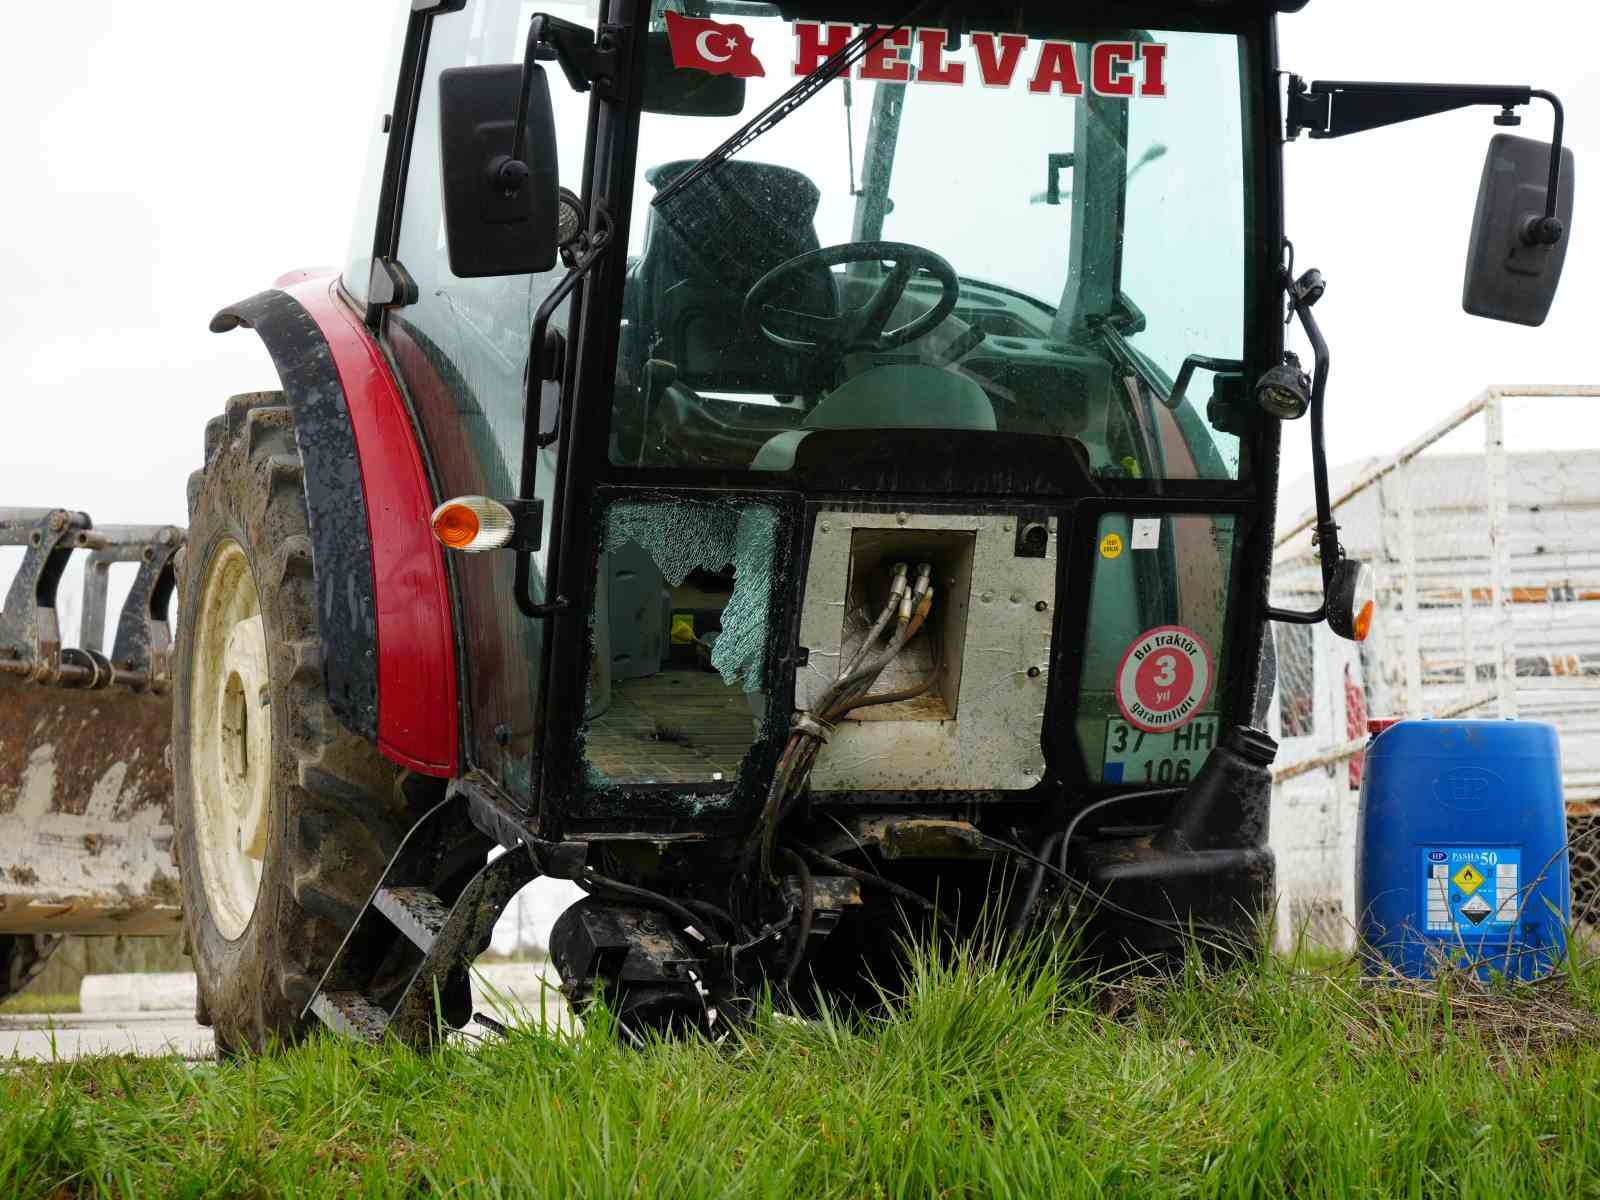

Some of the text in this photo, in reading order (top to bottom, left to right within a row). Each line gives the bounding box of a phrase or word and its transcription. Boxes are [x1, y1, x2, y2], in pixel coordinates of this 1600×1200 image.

[791, 19, 1168, 98] HELVACI
[1134, 634, 1198, 660] Bu traktör
[1153, 655, 1177, 686] 3
[1112, 722, 1215, 752] 37 HH
[1144, 758, 1190, 784] 106
[1480, 852, 1498, 865] 50
